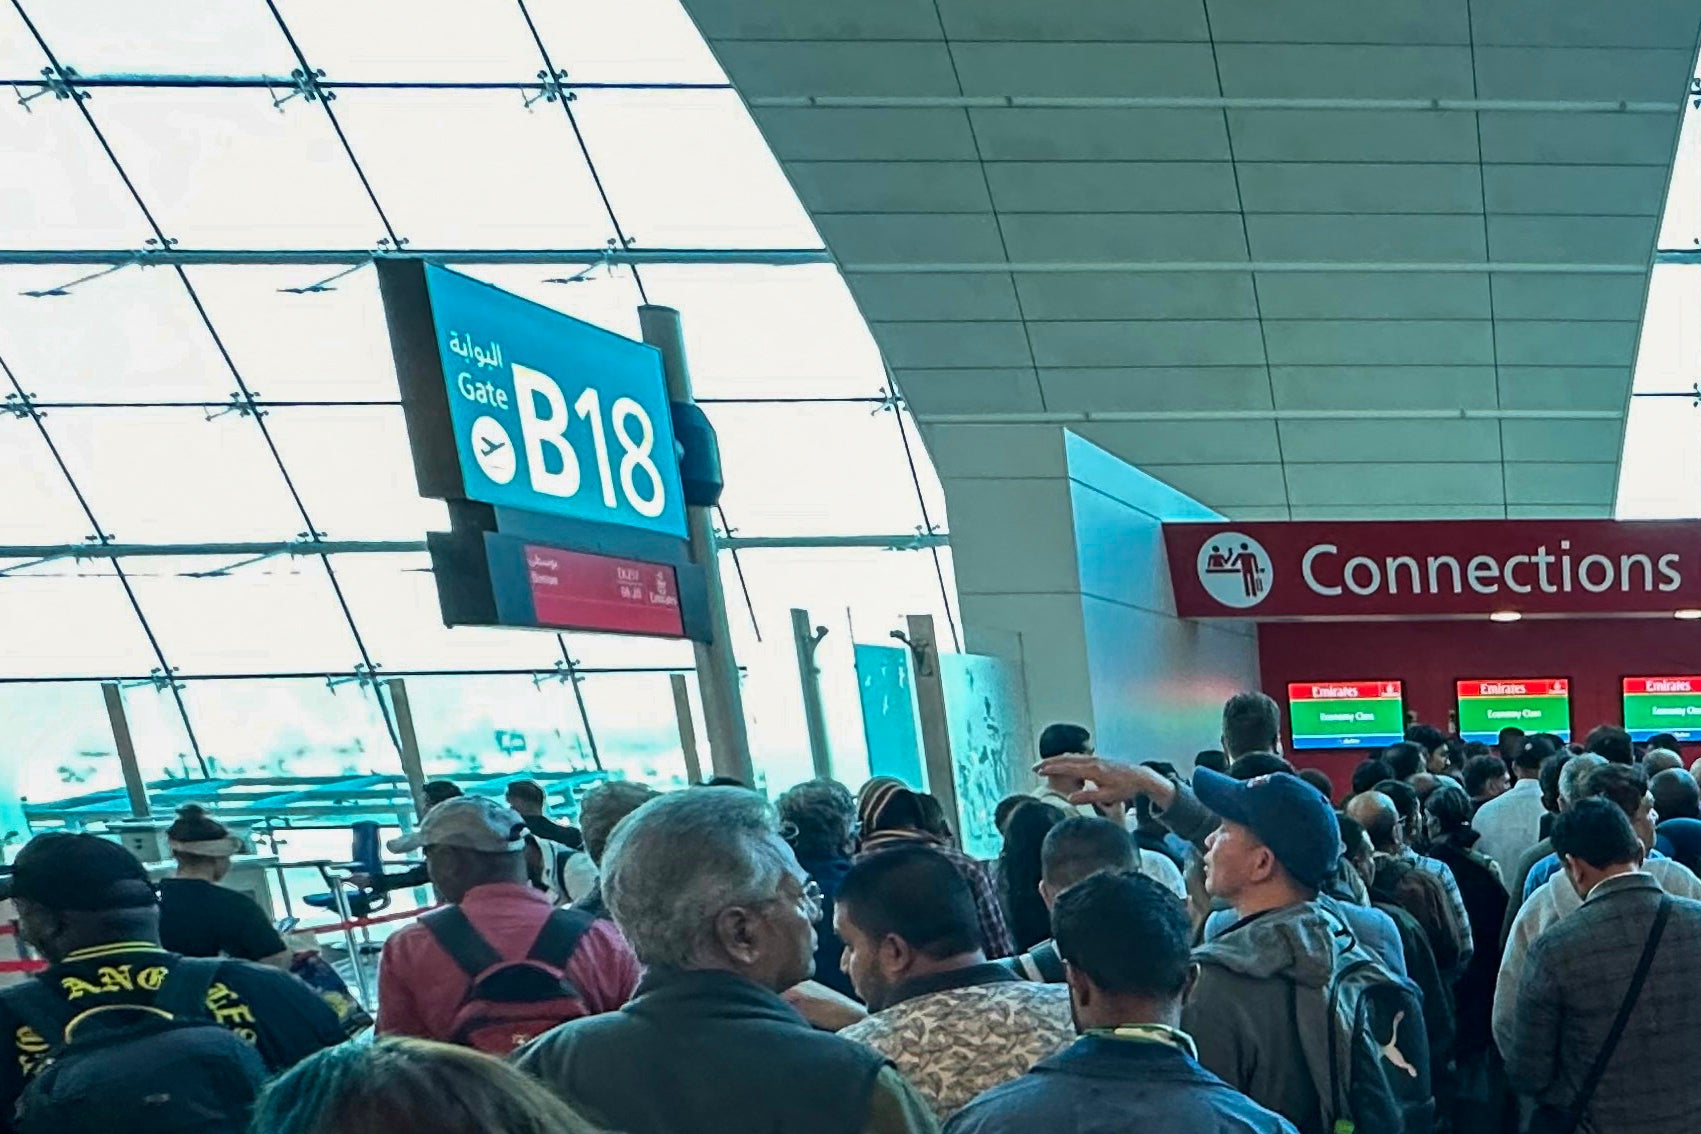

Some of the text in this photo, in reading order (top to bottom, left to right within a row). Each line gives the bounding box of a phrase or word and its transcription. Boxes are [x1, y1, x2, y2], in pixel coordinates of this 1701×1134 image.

[450, 330, 503, 371] البوابة
[458, 371, 509, 410] Gate
[511, 363, 666, 517] B18
[1301, 539, 1683, 596] Connections
[1312, 685, 1358, 698] Emirates
[1480, 683, 1526, 695] Emirates
[1646, 680, 1691, 692] Emirates
